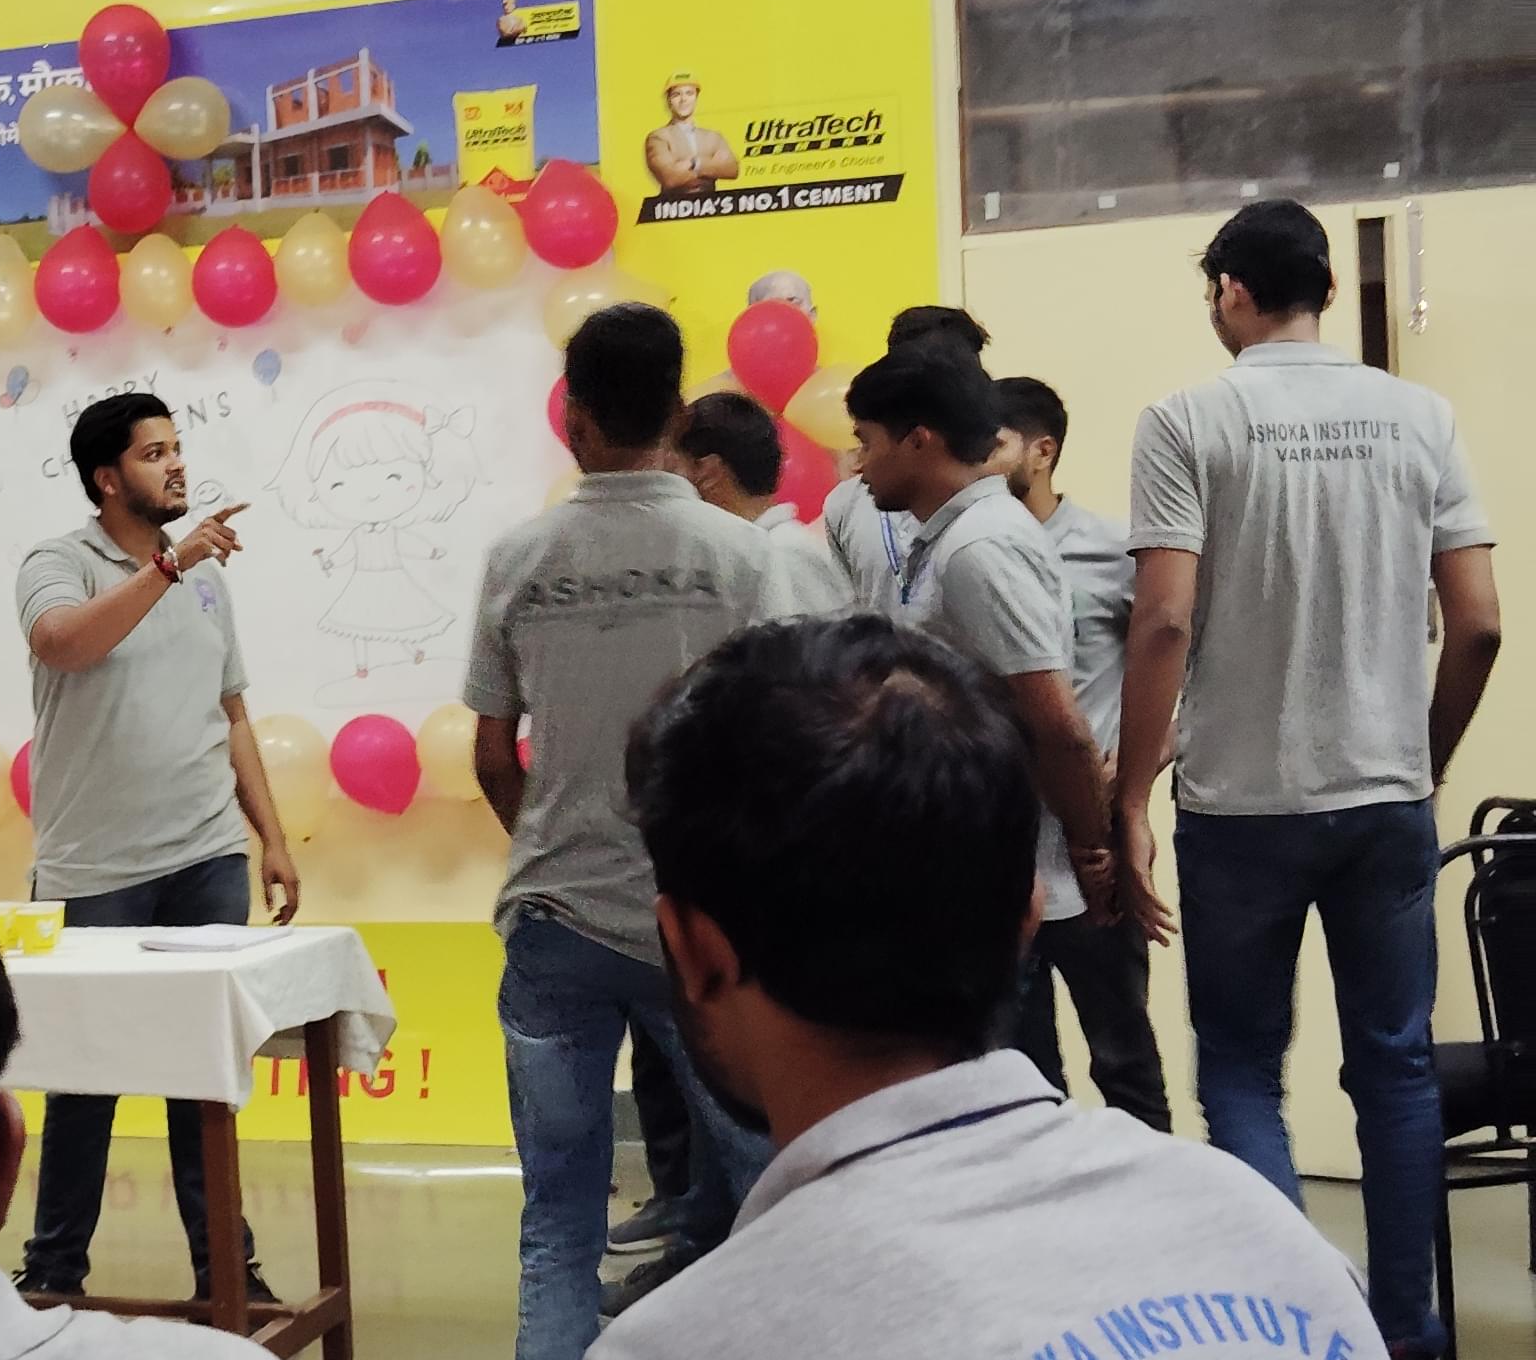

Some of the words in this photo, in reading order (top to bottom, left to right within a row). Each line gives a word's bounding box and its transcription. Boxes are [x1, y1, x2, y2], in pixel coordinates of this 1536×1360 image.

[744, 108, 883, 143] UltraTech
[770, 158, 837, 176] Engineer's
[839, 153, 886, 169] Choice
[654, 195, 735, 221] INDIA'S
[738, 186, 790, 214] NO.1
[793, 181, 885, 209] CEMENT
[1247, 422, 1310, 444] ASHOKA
[1274, 443, 1373, 463] VARANASI
[523, 566, 719, 610] ASHOKA
